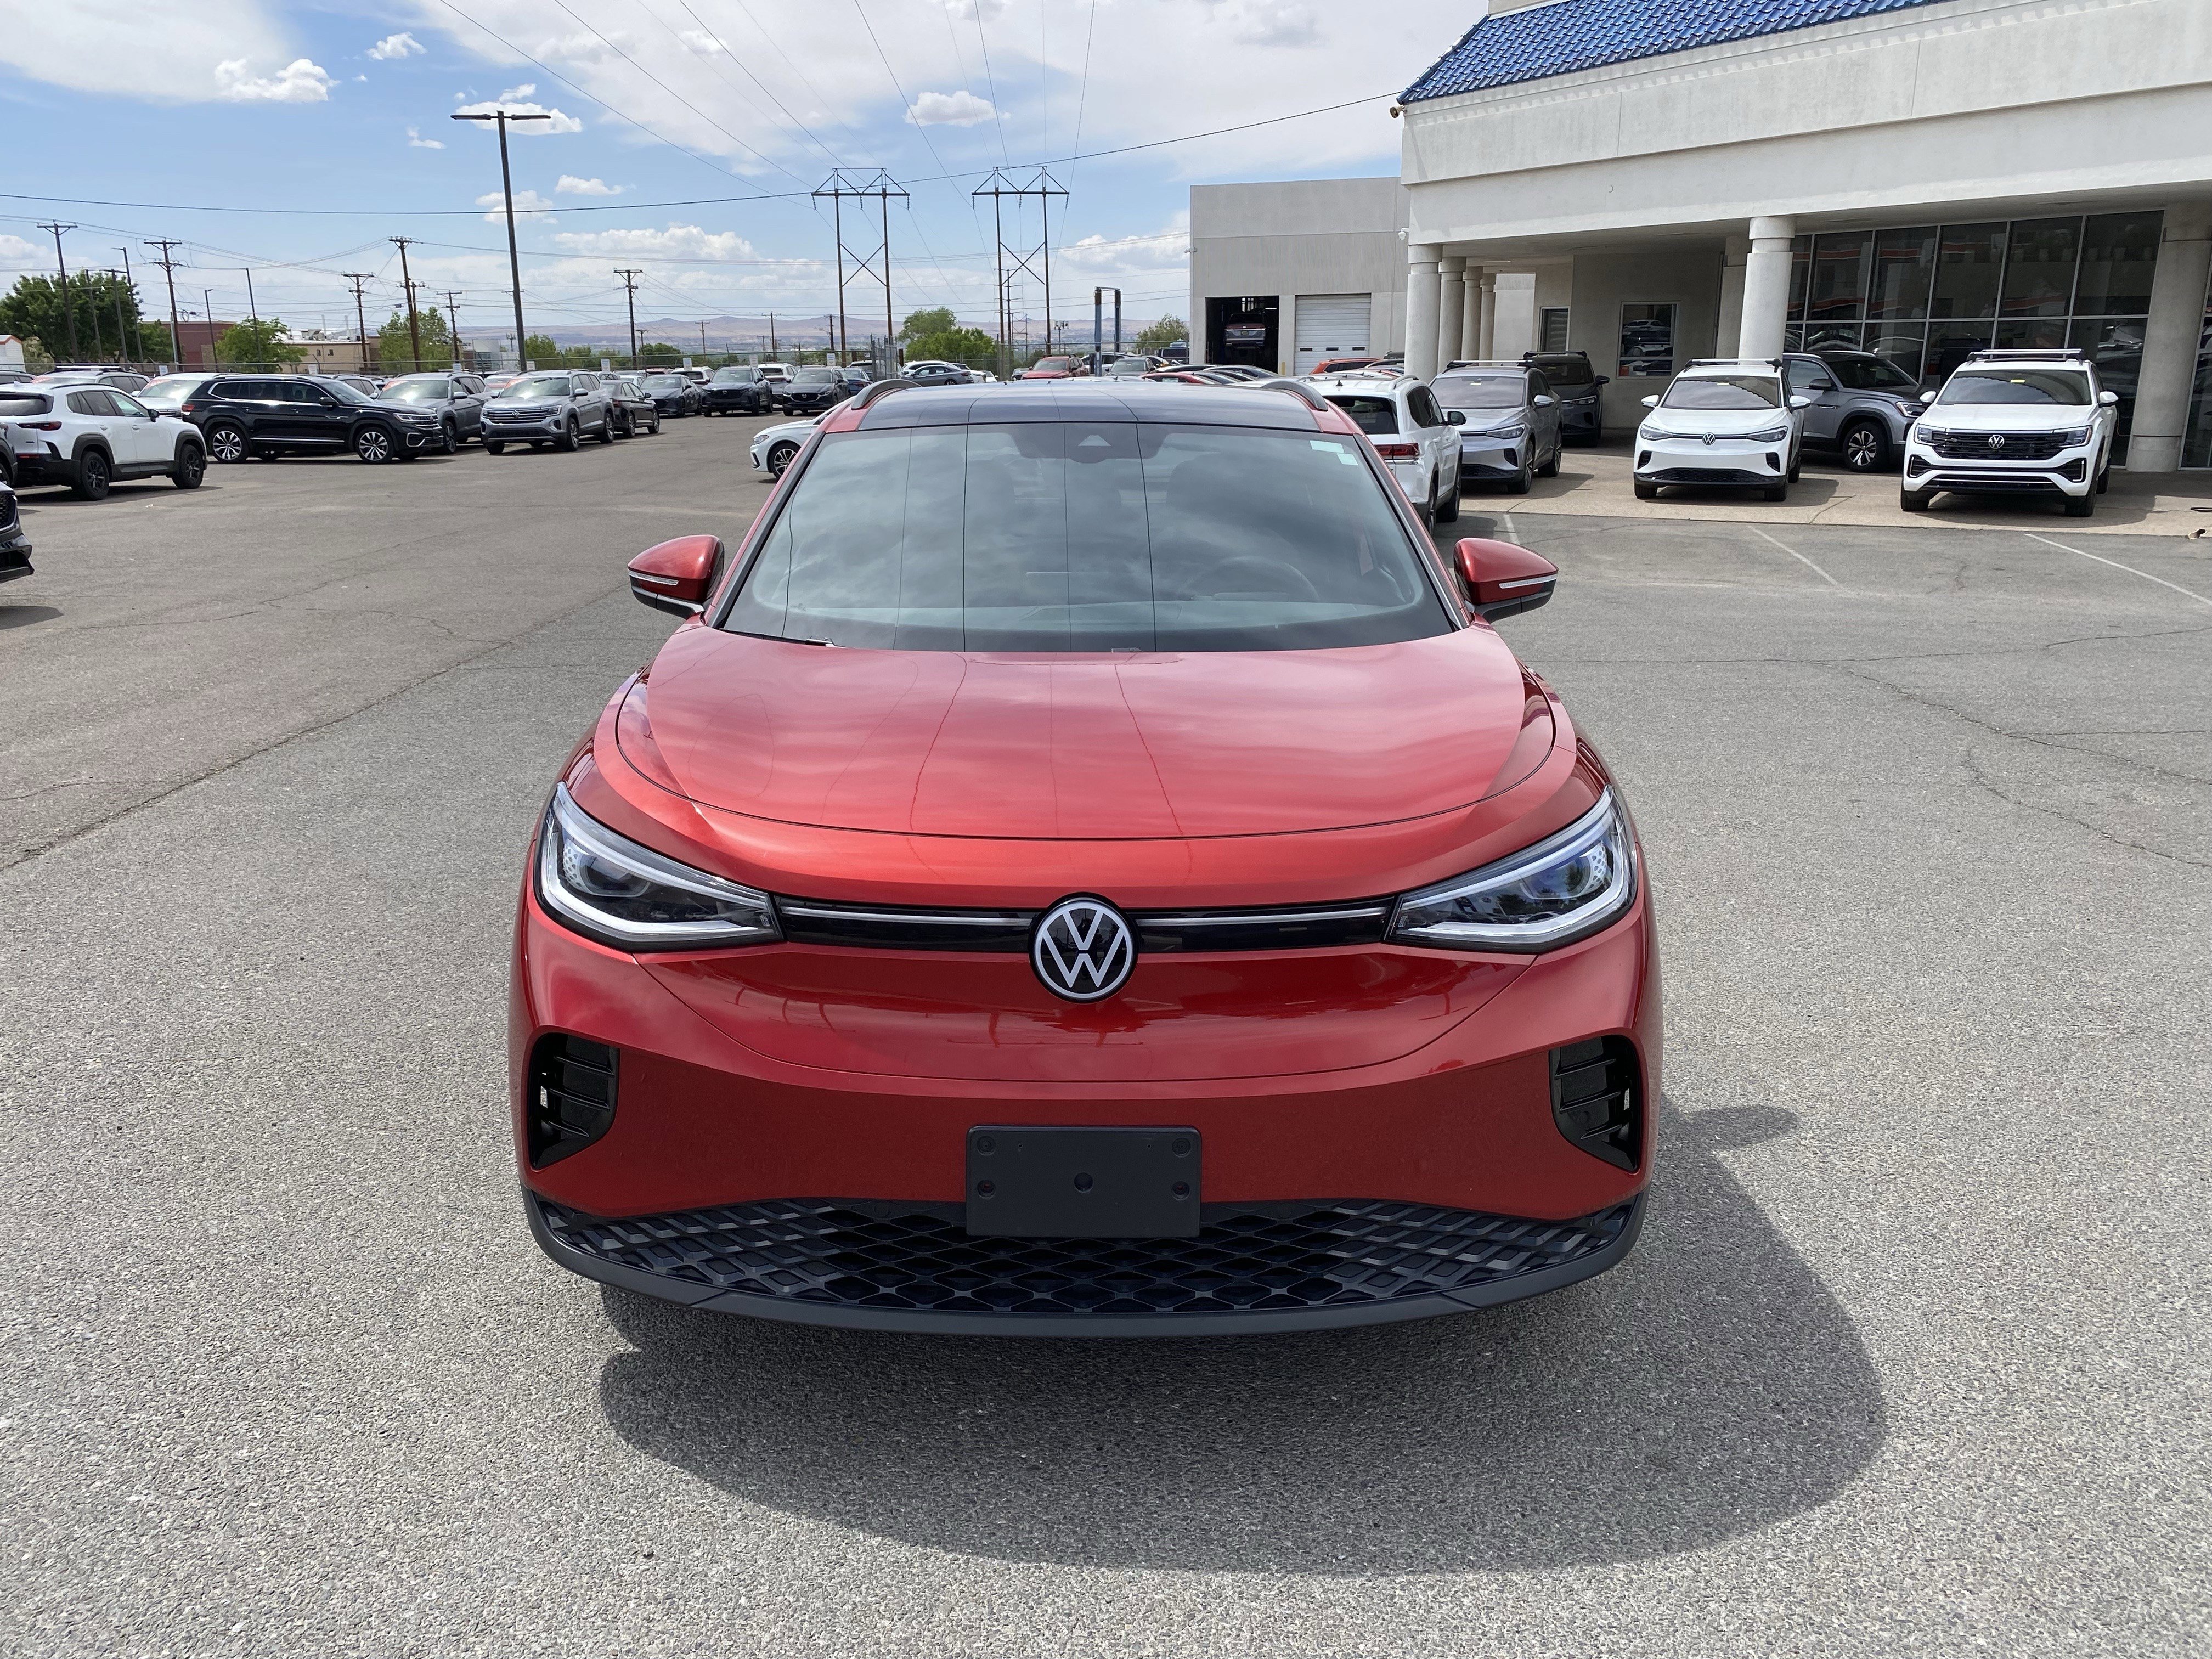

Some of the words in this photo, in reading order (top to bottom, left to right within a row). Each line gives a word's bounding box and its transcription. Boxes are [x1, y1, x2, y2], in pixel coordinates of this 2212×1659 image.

[1703, 432, 1715, 445] VW
[1989, 435, 2004, 449] VW
[1036, 903, 1132, 997] VW
